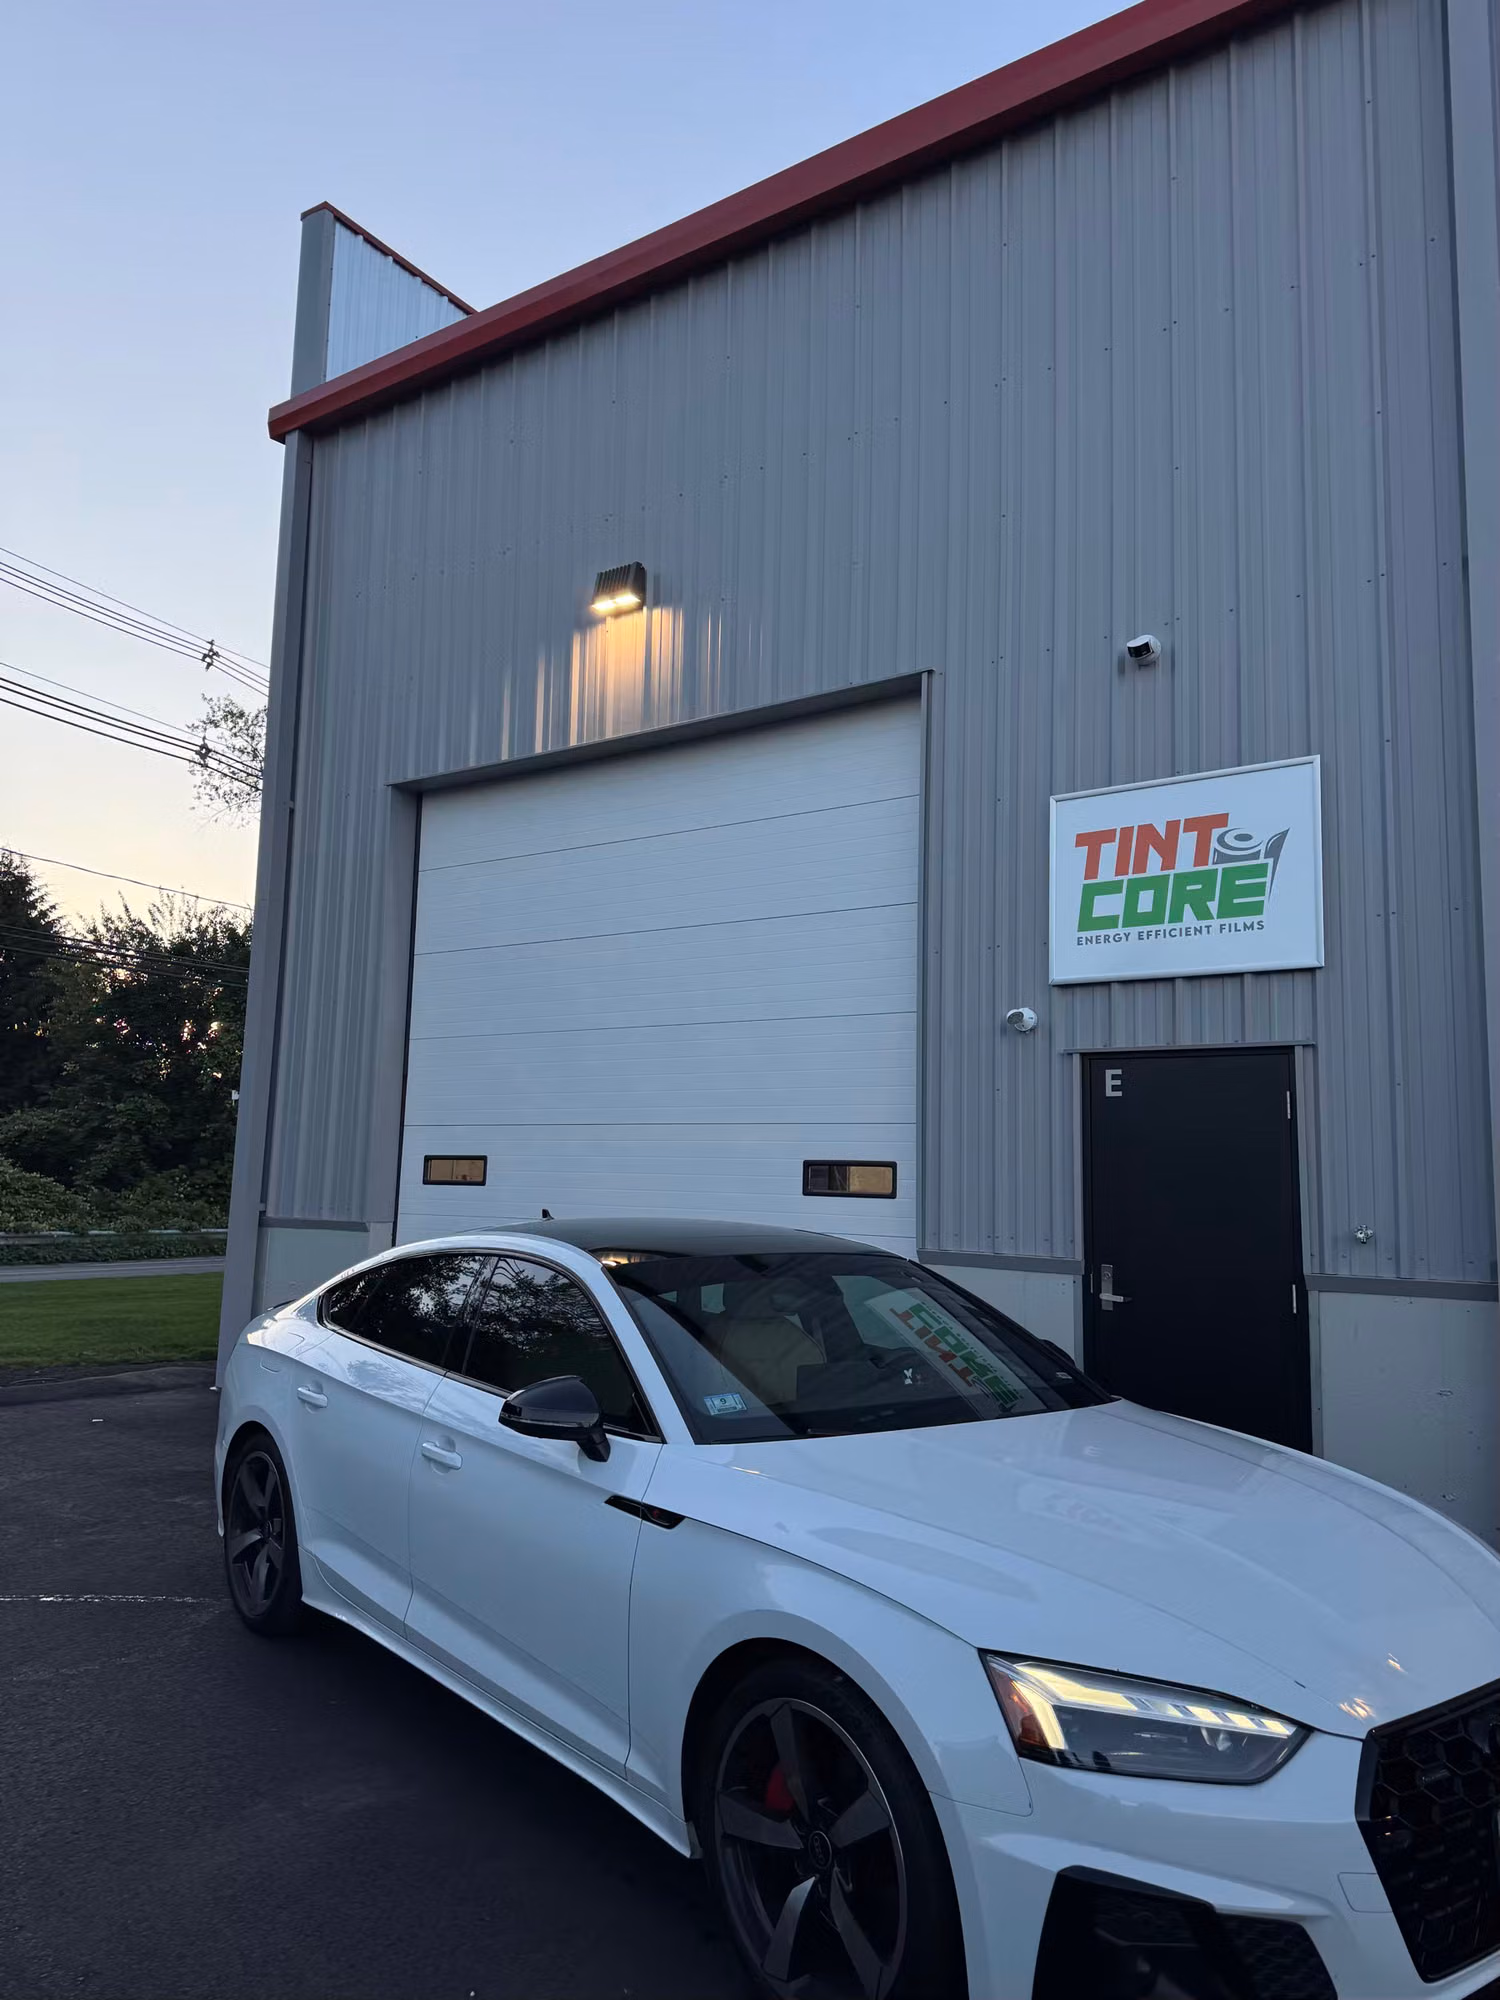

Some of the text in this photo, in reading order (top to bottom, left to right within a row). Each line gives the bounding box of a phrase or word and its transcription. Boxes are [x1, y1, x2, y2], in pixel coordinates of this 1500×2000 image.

[1075, 812, 1229, 880] TINT
[1077, 862, 1269, 932] CORE
[1077, 920, 1265, 946] ENERGY EFFICIENT FILMS
[1105, 1069, 1123, 1097] E
[720, 1397, 727, 1405] 9
